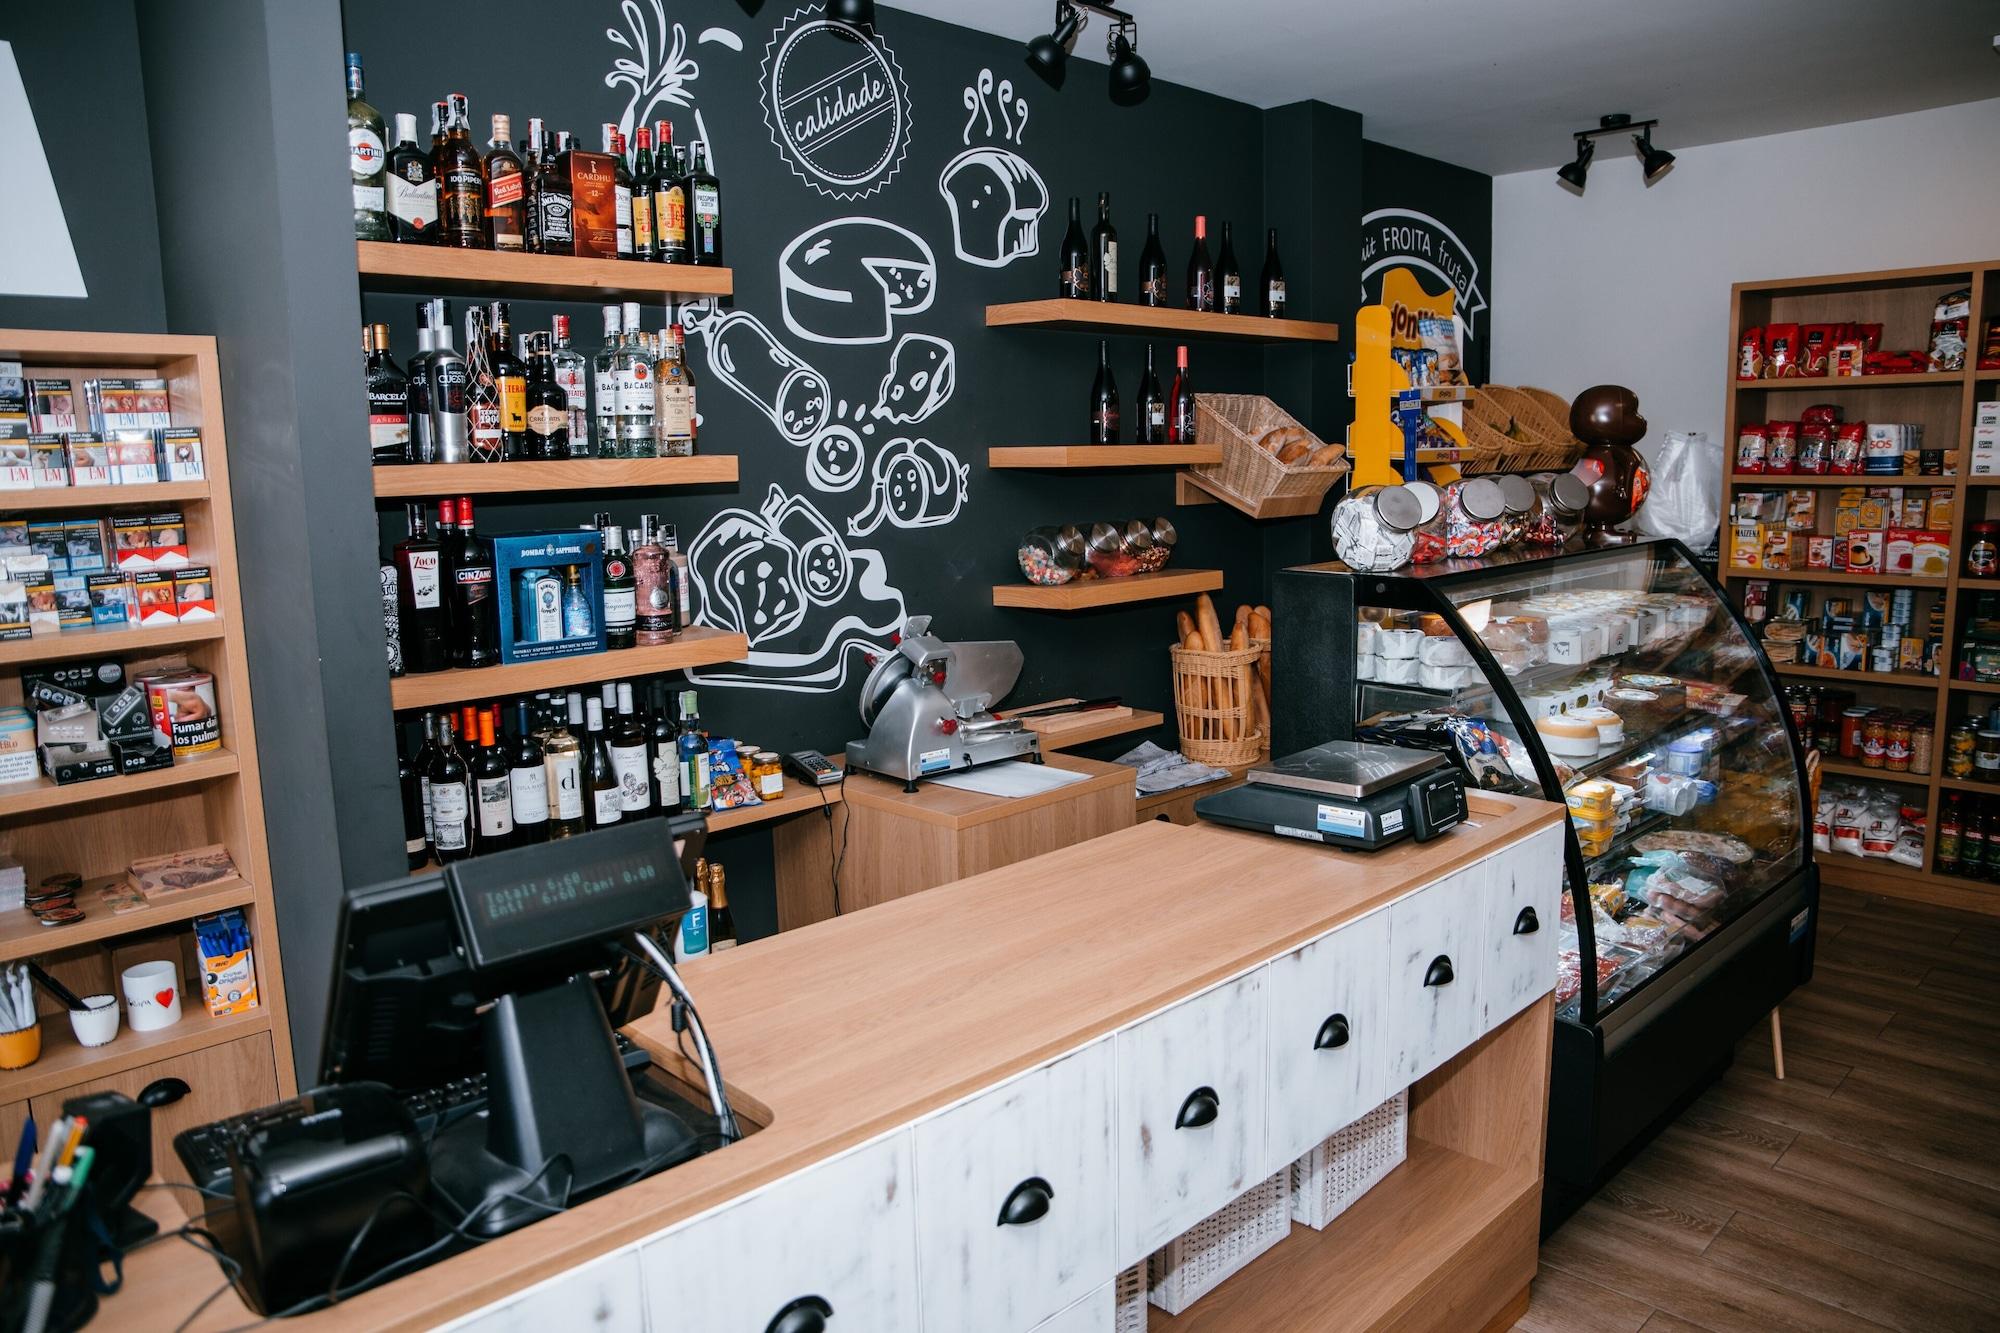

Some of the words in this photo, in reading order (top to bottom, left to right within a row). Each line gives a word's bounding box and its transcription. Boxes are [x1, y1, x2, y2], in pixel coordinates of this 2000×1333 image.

[795, 72, 885, 142] calidade
[577, 172, 611, 182] CARDHU
[494, 186, 507, 196] Red
[1383, 227, 1431, 256] FROITA
[1439, 240, 1467, 292] fruta
[369, 391, 408, 401] BARCELÓ
[1870, 440, 1892, 449] SOS
[1735, 529, 1760, 537] MAIZENA
[521, 549, 545, 558] BOMBAY
[54, 667, 94, 681] OCB
[40, 688, 76, 705] OCB
[112, 694, 132, 713] OCB
[173, 721, 205, 734] Fumar
[175, 736, 189, 745] los
[126, 757, 146, 766] OCB
[96, 765, 114, 773] OCB
[562, 768, 575, 791] d
[691, 912, 701, 928] F
